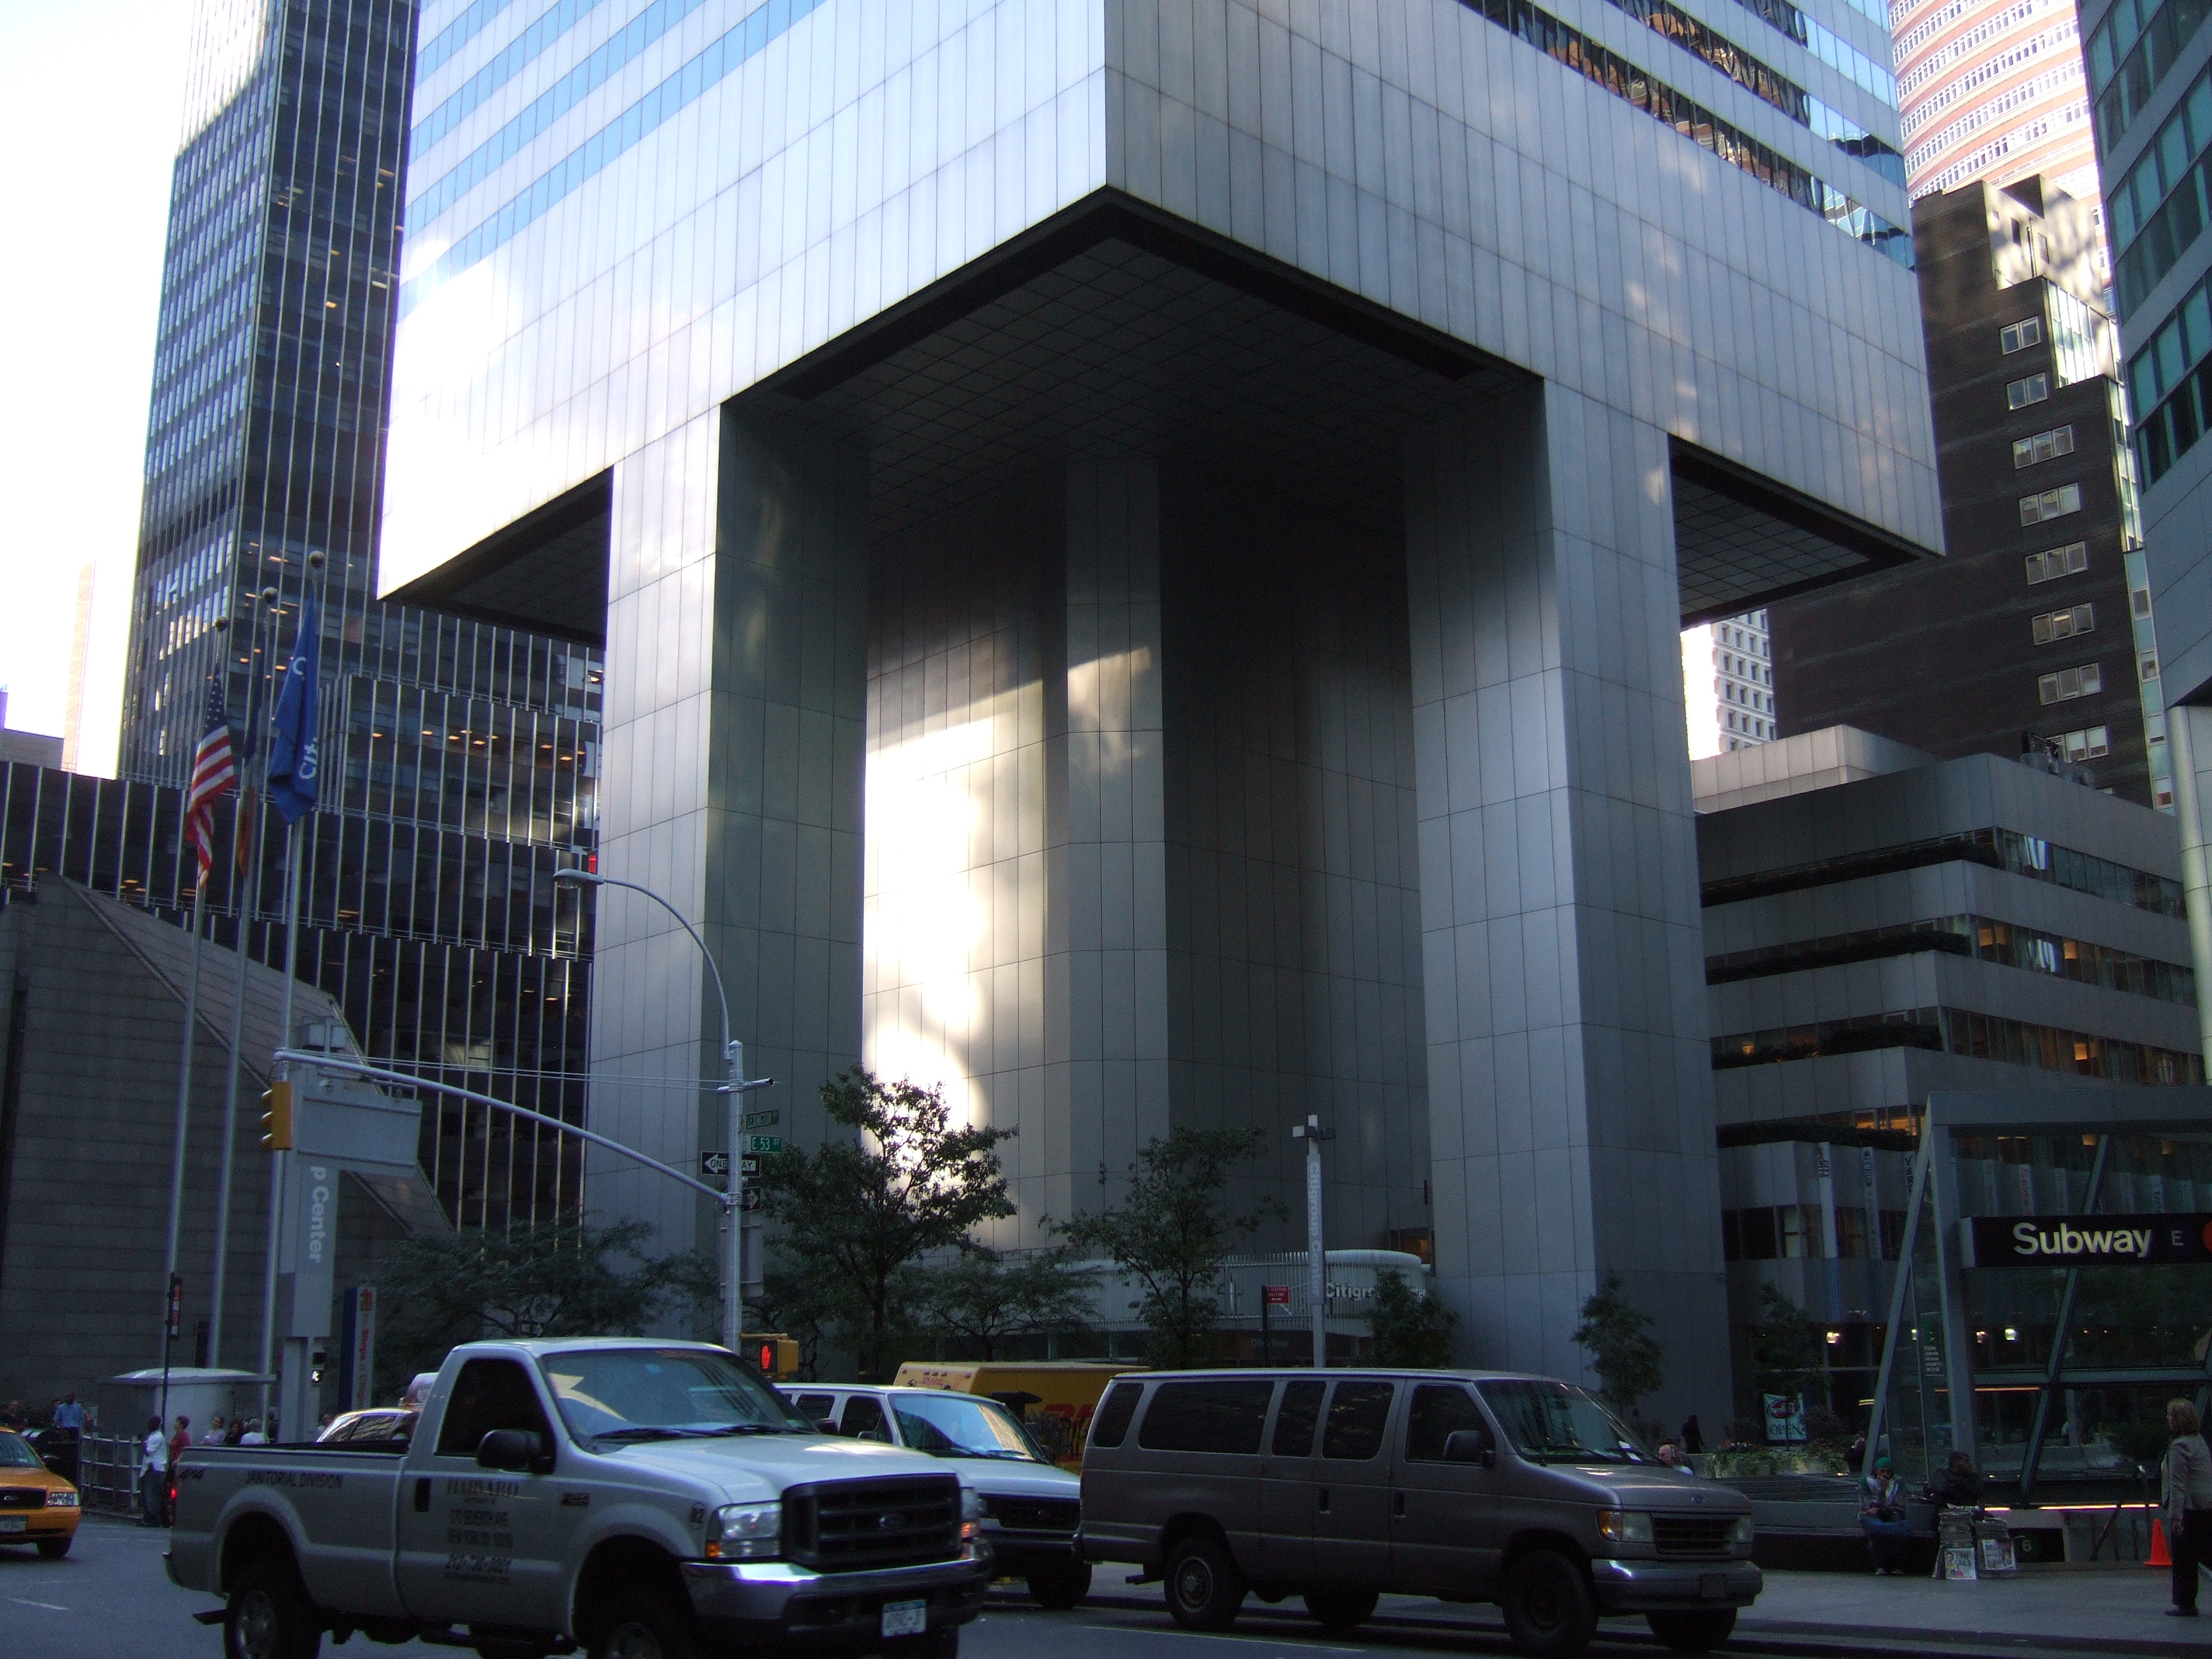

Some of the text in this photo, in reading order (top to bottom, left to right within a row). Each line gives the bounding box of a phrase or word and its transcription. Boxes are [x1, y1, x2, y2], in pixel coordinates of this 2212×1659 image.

[752, 1137, 756, 1150] E
[760, 1137, 770, 1150] 53
[710, 1159, 727, 1169] ONE
[308, 1185, 331, 1264] Center
[1309, 1160, 1321, 1298] Citigroup Center
[2012, 1221, 2185, 1258] Subway E
[245, 1469, 344, 1489] JANITORIAL DIVISION
[2022, 1539, 2032, 1553] 6
